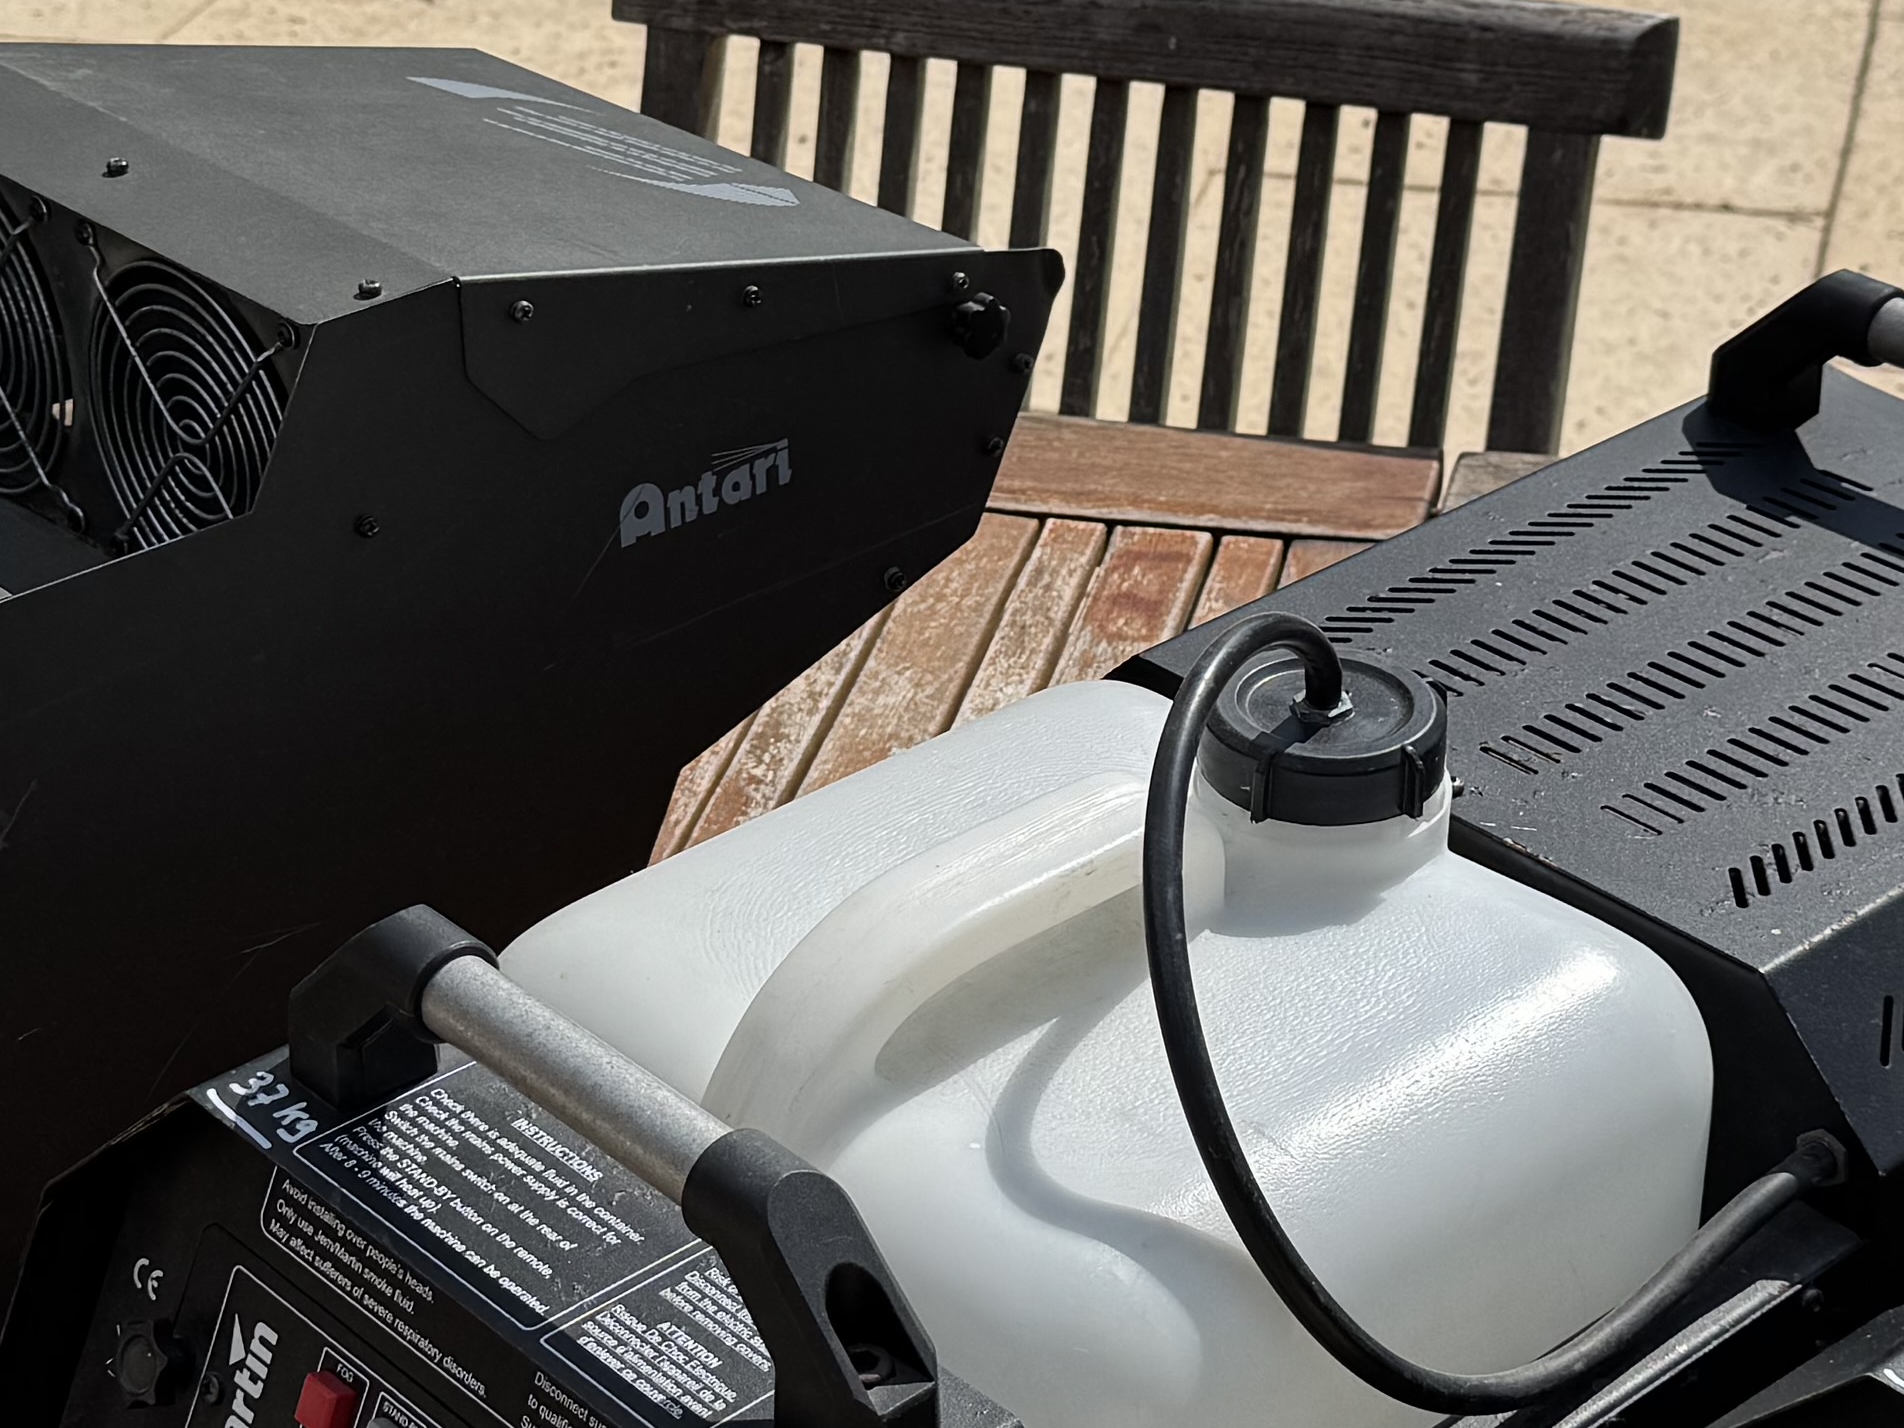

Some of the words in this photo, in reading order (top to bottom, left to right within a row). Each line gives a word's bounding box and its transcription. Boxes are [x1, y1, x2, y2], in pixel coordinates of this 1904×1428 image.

[619, 438, 793, 548] Antari
[228, 1070, 290, 1107] 37
[527, 1393, 538, 1409] to
